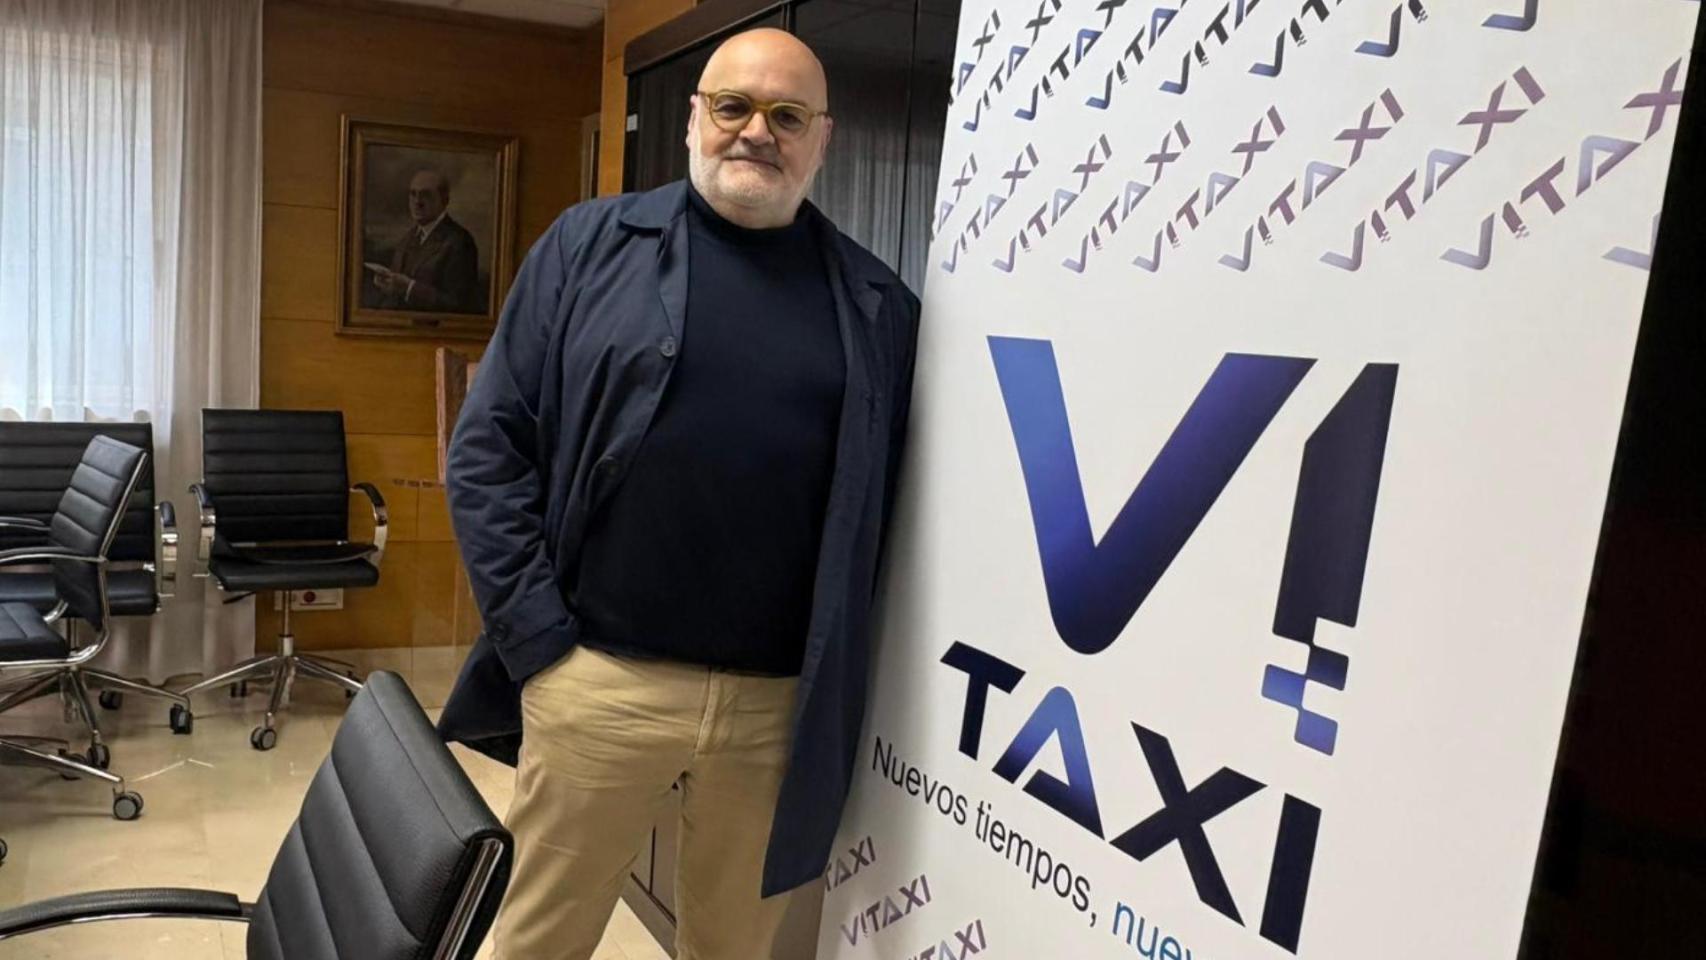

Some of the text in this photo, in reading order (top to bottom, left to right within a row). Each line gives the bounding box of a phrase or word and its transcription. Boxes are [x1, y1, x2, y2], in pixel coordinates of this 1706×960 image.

[950, 8, 1001, 106] AXI
[1085, 0, 1187, 110] VITA
[940, 142, 1040, 274] VITAXI
[992, 133, 1112, 273] VITAXI
[1062, 120, 1191, 273] VITAXI
[1132, 105, 1286, 272] VITAXI
[1217, 88, 1405, 272] VITAXI
[1319, 66, 1546, 272] VITAXI
[987, 335, 1399, 757] VI
[872, 736, 1192, 960] Nuevos tiempos, nue
[940, 640, 1322, 955] TAXI
[840, 874, 932, 946] VITAXI
